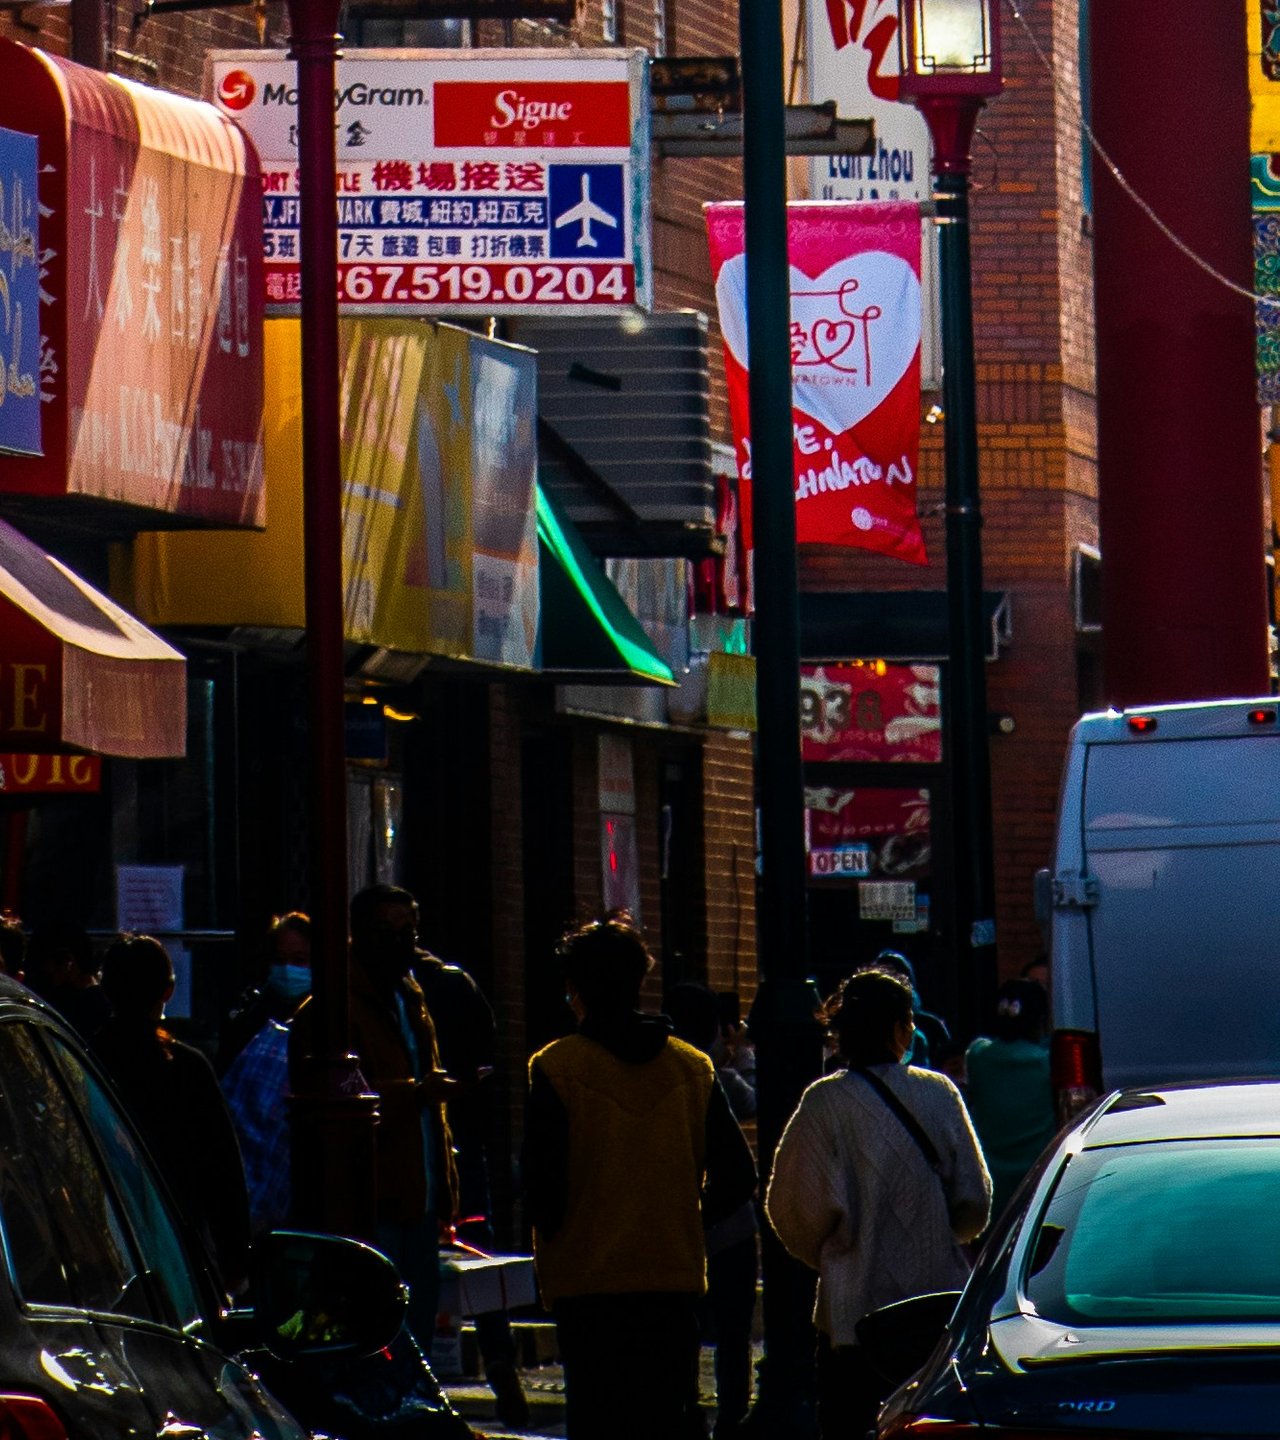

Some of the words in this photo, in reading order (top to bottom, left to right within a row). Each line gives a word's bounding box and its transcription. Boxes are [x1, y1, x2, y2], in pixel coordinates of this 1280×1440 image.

[263, 81, 425, 110] MoyGram
[490, 89, 573, 129] Sigue
[371, 159, 545, 193] 機場接送
[337, 265, 628, 302] 67.519.0204
[815, 851, 865, 872] OPEN
